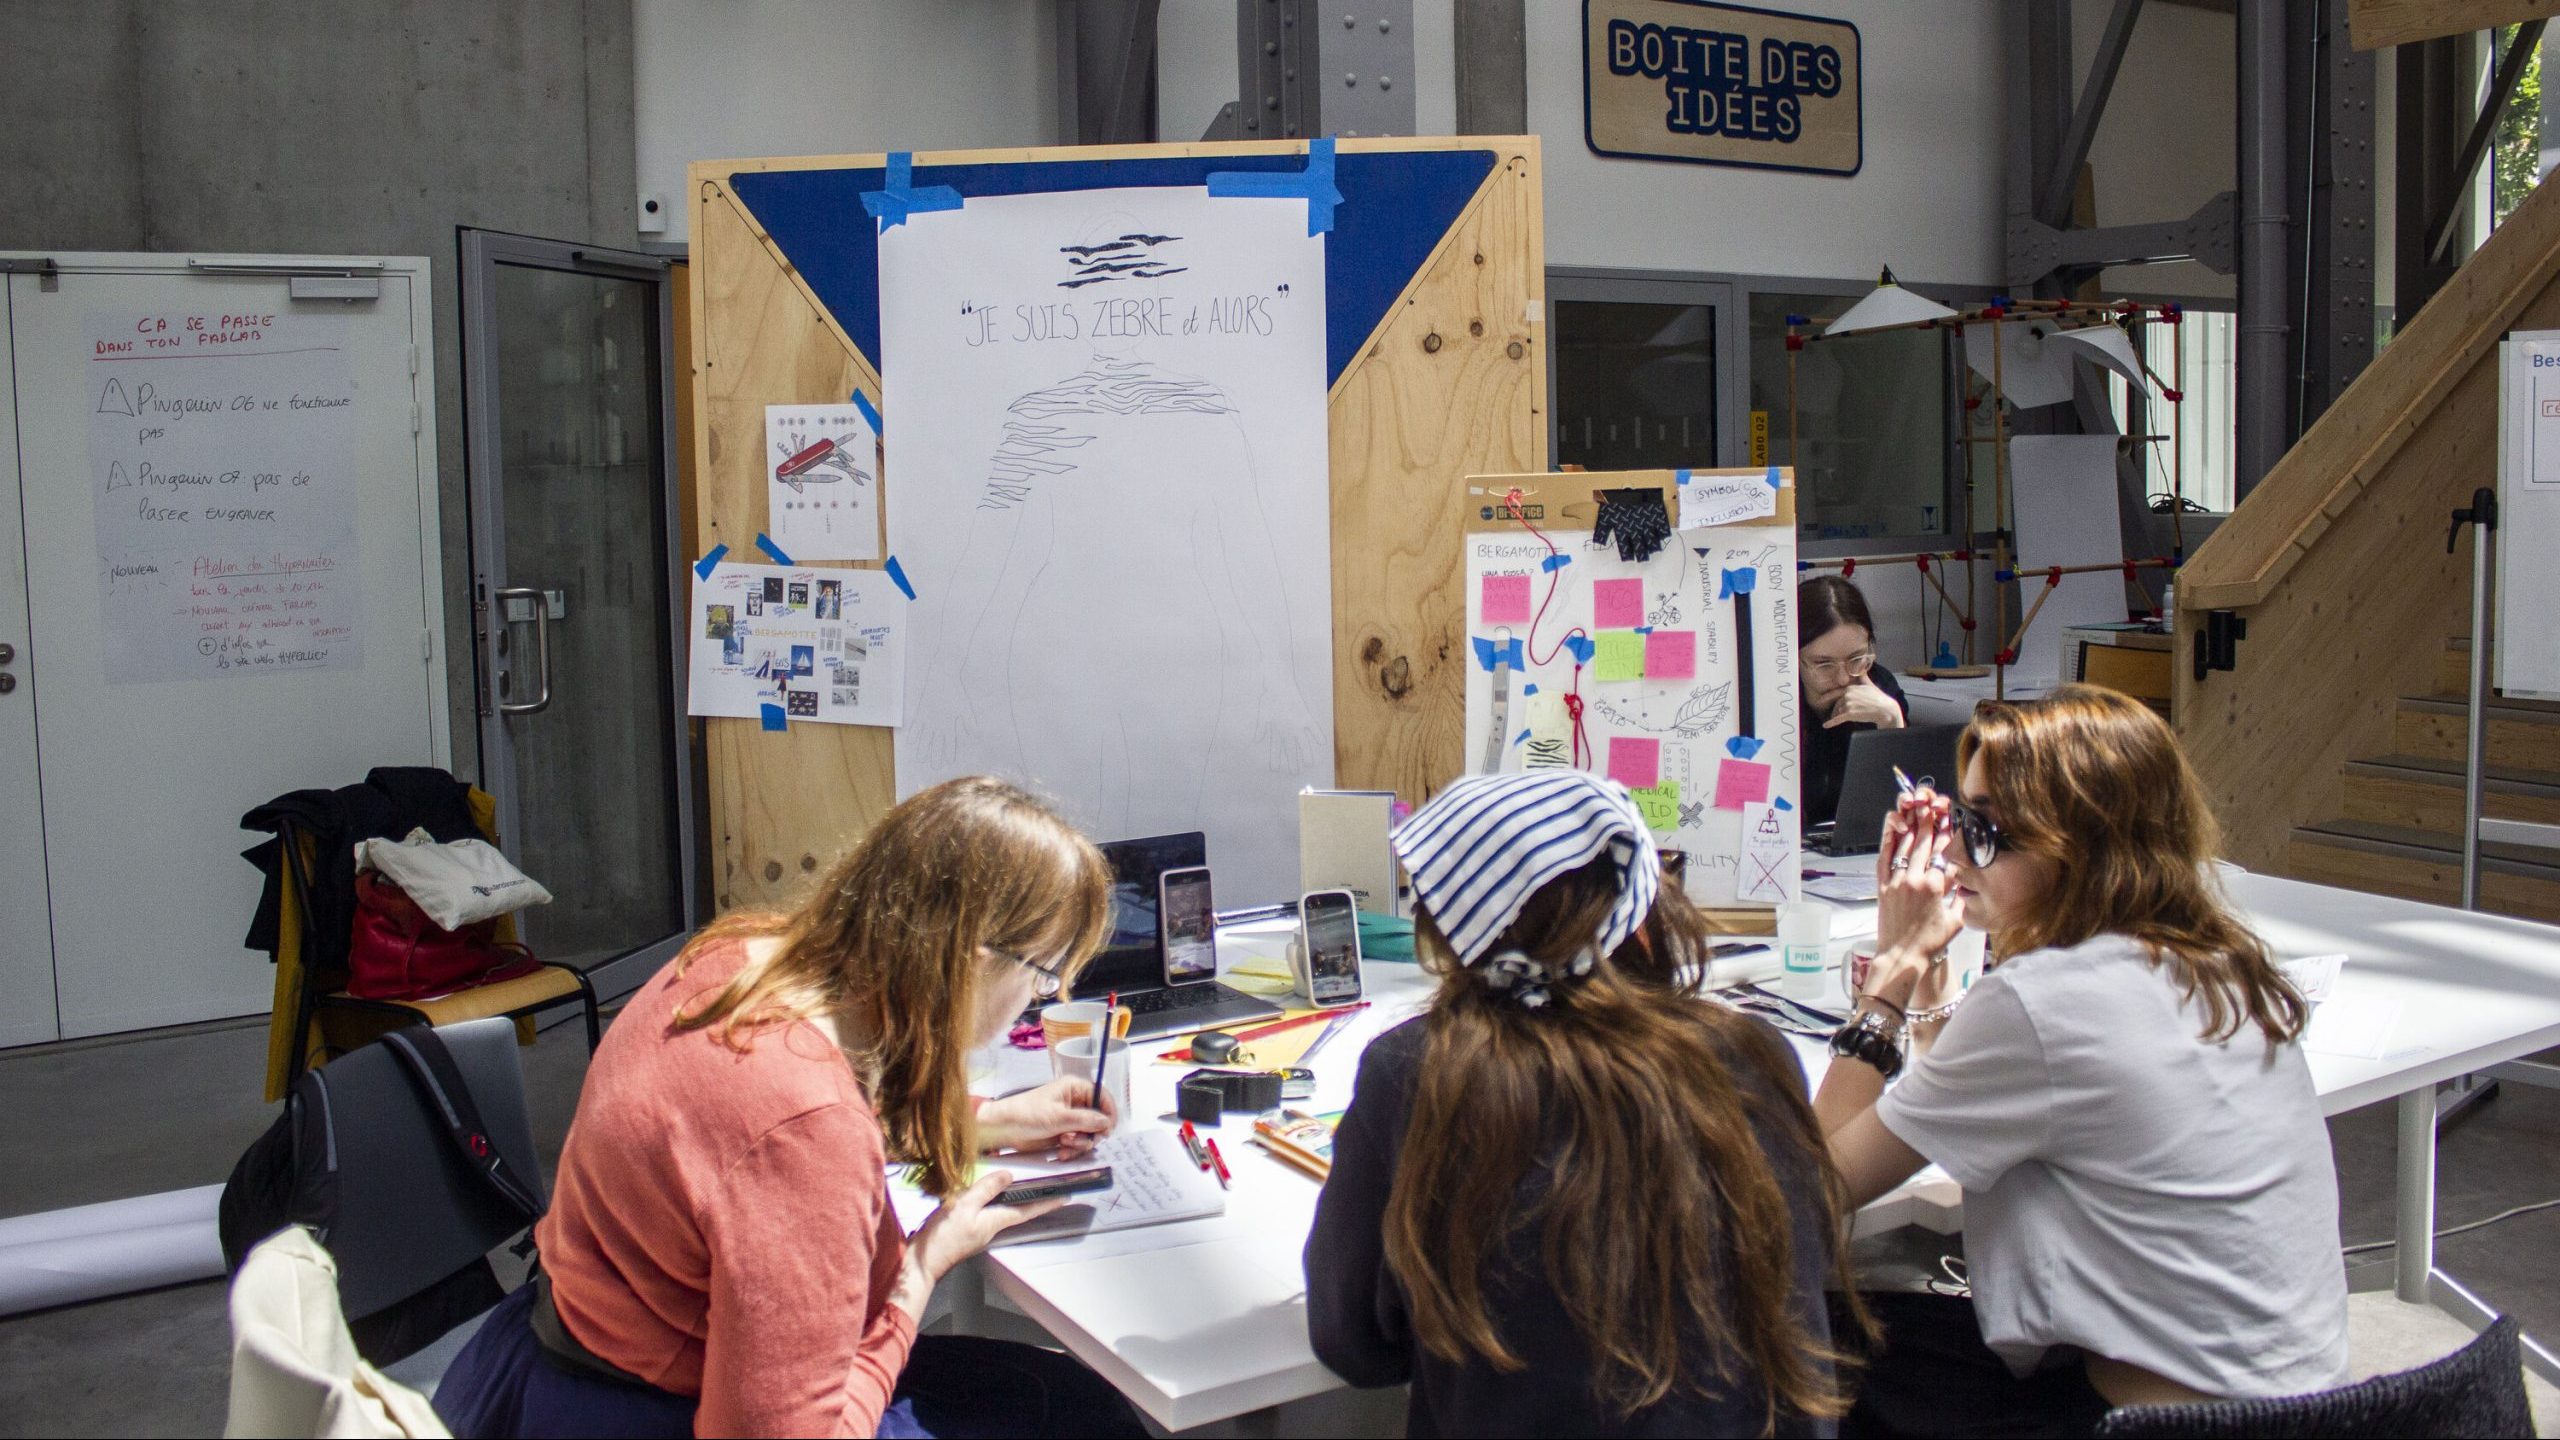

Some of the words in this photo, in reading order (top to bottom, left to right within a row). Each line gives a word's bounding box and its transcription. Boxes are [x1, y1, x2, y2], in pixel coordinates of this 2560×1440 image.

[1613, 28, 1743, 81] BOITE
[1766, 46, 1837, 91] DES
[1671, 83, 1796, 135] IDÉES
[137, 317, 168, 333] CA
[186, 316, 205, 331] SE
[220, 314, 276, 329] PASSE
[1012, 303, 1079, 342] SUIS
[1091, 297, 1174, 338] ZEBRE
[1183, 305, 1200, 336] et
[95, 339, 133, 354] DANS
[145, 336, 181, 349] TON
[198, 330, 262, 346] FABLAB
[230, 399, 255, 412] 06
[1755, 416, 1765, 431] 02
[1755, 436, 1766, 467] LABO
[253, 477, 282, 493] pas
[291, 470, 311, 486] de
[1698, 484, 1740, 500] SYMBOL
[1749, 486, 1767, 500] OF
[1699, 561, 1714, 613] INDUSTRIAL
[1767, 563, 1784, 591] BODY
[1773, 599, 1791, 674] MODIFICATION
